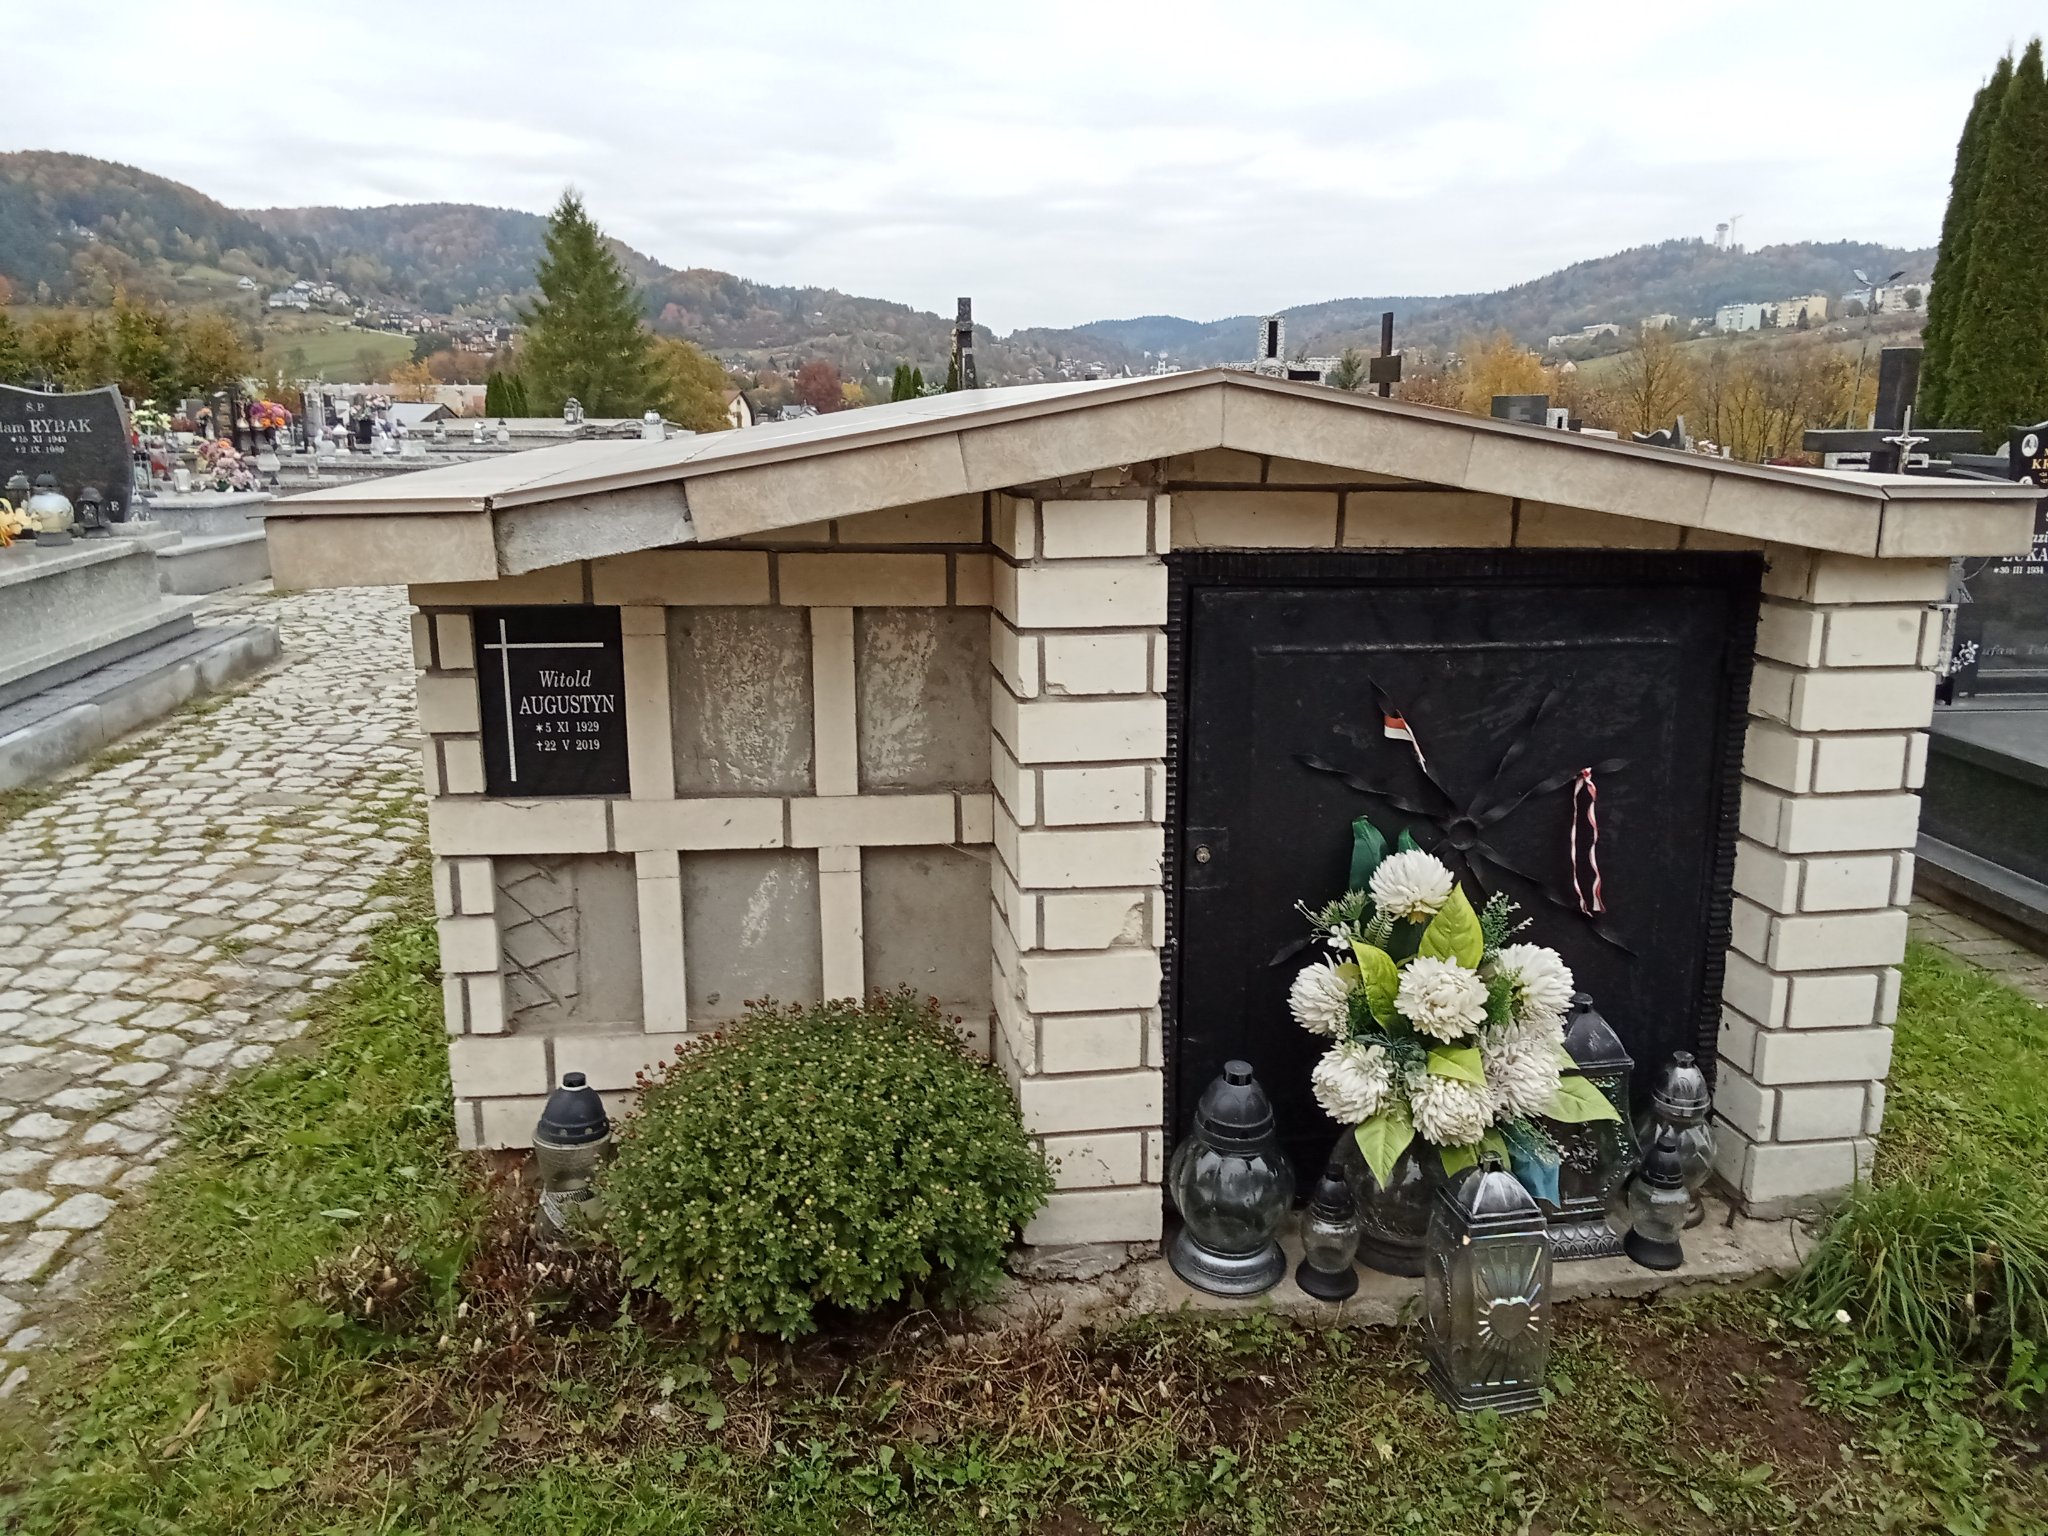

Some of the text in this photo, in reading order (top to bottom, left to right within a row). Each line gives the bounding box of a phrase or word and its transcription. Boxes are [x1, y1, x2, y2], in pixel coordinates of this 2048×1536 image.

[29, 419, 92, 434] RYBAK
[539, 669, 592, 688] Witold
[519, 694, 615, 715] AUGUSTYN
[557, 721, 570, 733] XI
[576, 720, 600, 733] 1929
[562, 739, 571, 751] V
[576, 739, 601, 751] 2019
